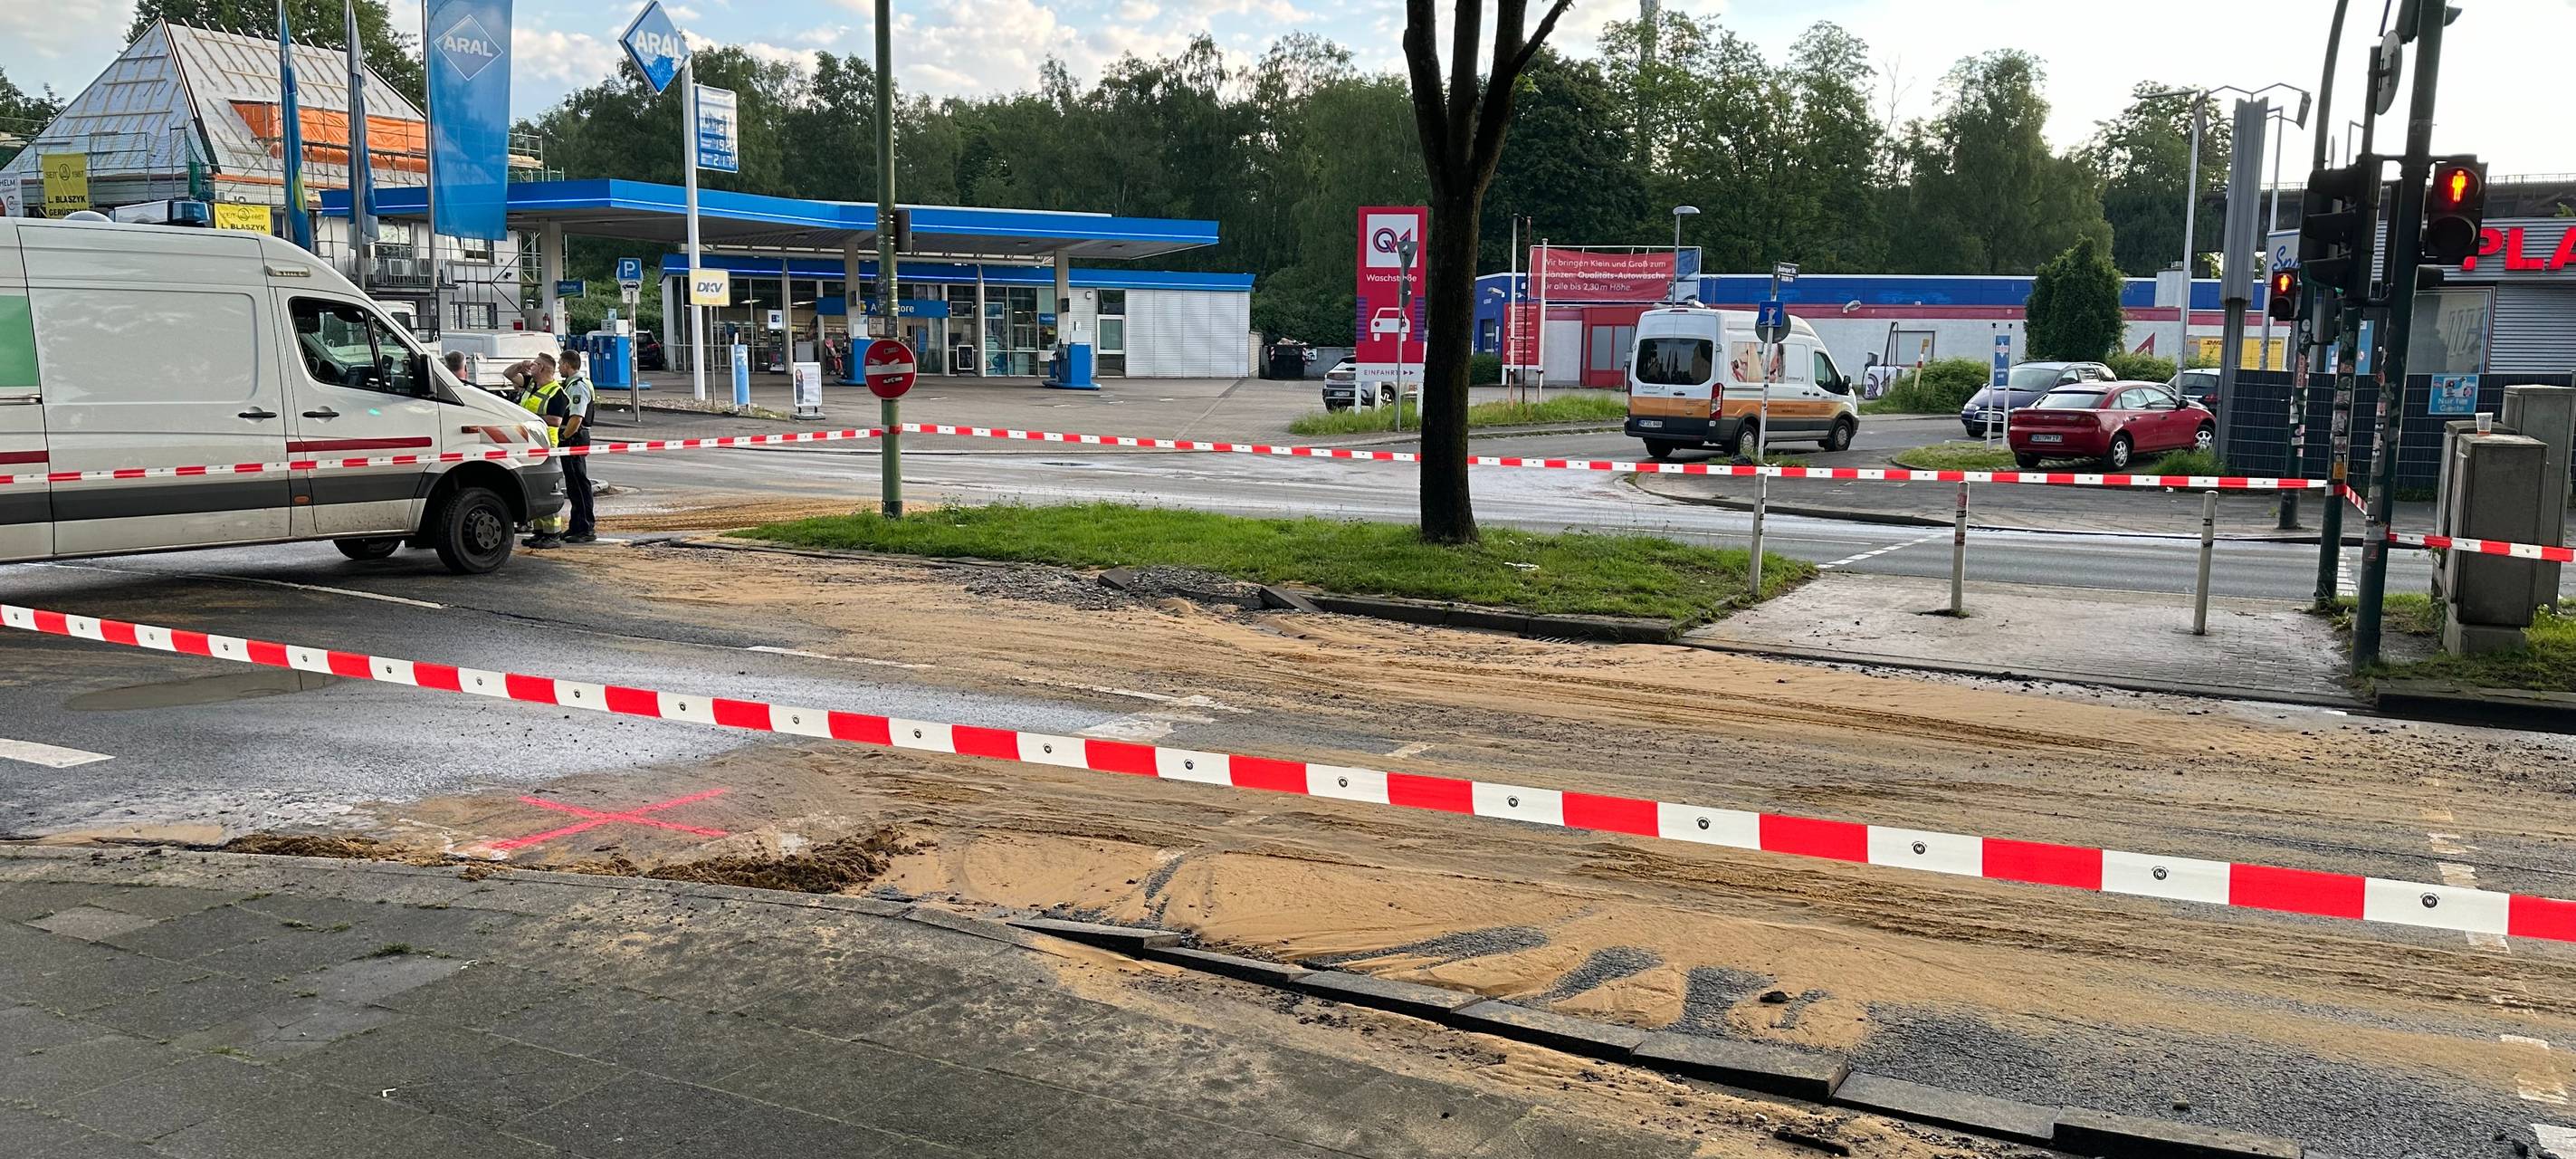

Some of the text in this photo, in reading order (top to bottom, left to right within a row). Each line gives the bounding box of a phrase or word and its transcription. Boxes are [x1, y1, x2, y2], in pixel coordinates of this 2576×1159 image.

[444, 35, 493, 57] ARAL
[635, 30, 681, 60] ARAL
[48, 195, 86, 204] L. BLASZYK
[624, 261, 635, 277] P
[1558, 259, 1589, 269] bringen
[1628, 260, 1648, 268] Groß
[696, 282, 723, 293] DKV
[1569, 283, 1581, 291] bis
[1609, 283, 1633, 292] Höhe.
